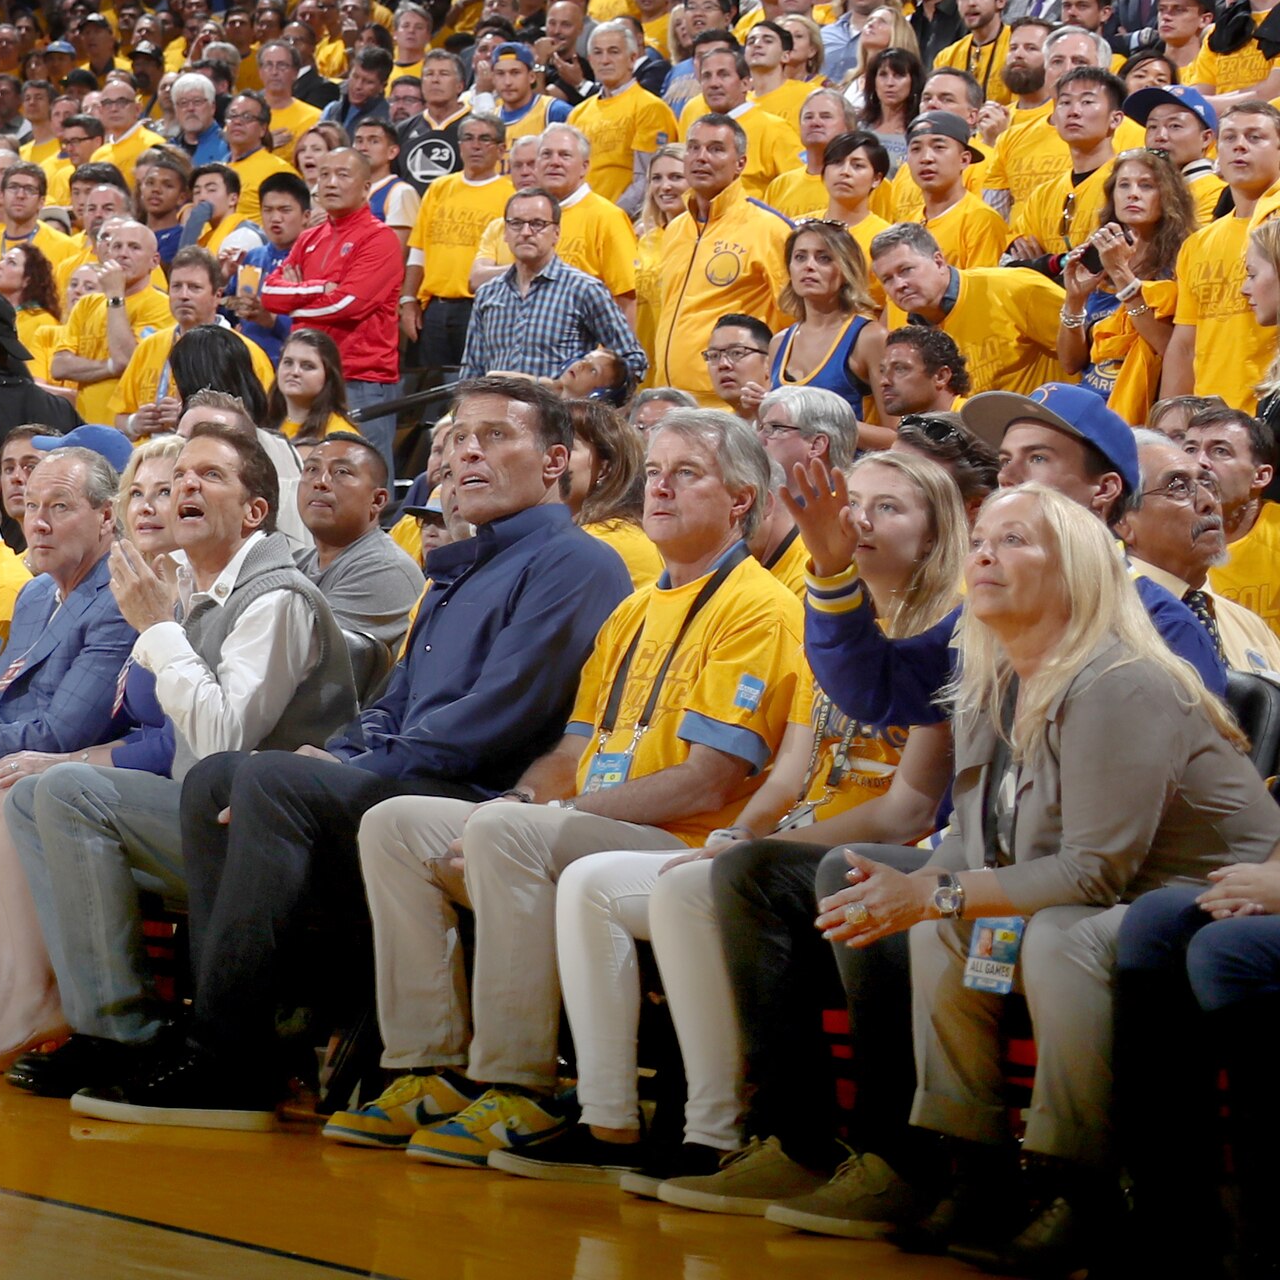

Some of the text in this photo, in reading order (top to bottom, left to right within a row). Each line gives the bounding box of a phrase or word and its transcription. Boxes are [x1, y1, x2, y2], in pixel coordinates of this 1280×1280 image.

[430, 147, 451, 161] 23
[713, 244, 748, 255] CITY
[1084, 372, 1117, 392] WARR
[808, 704, 832, 770] WARRIORS
[984, 963, 1011, 978] GAMES
